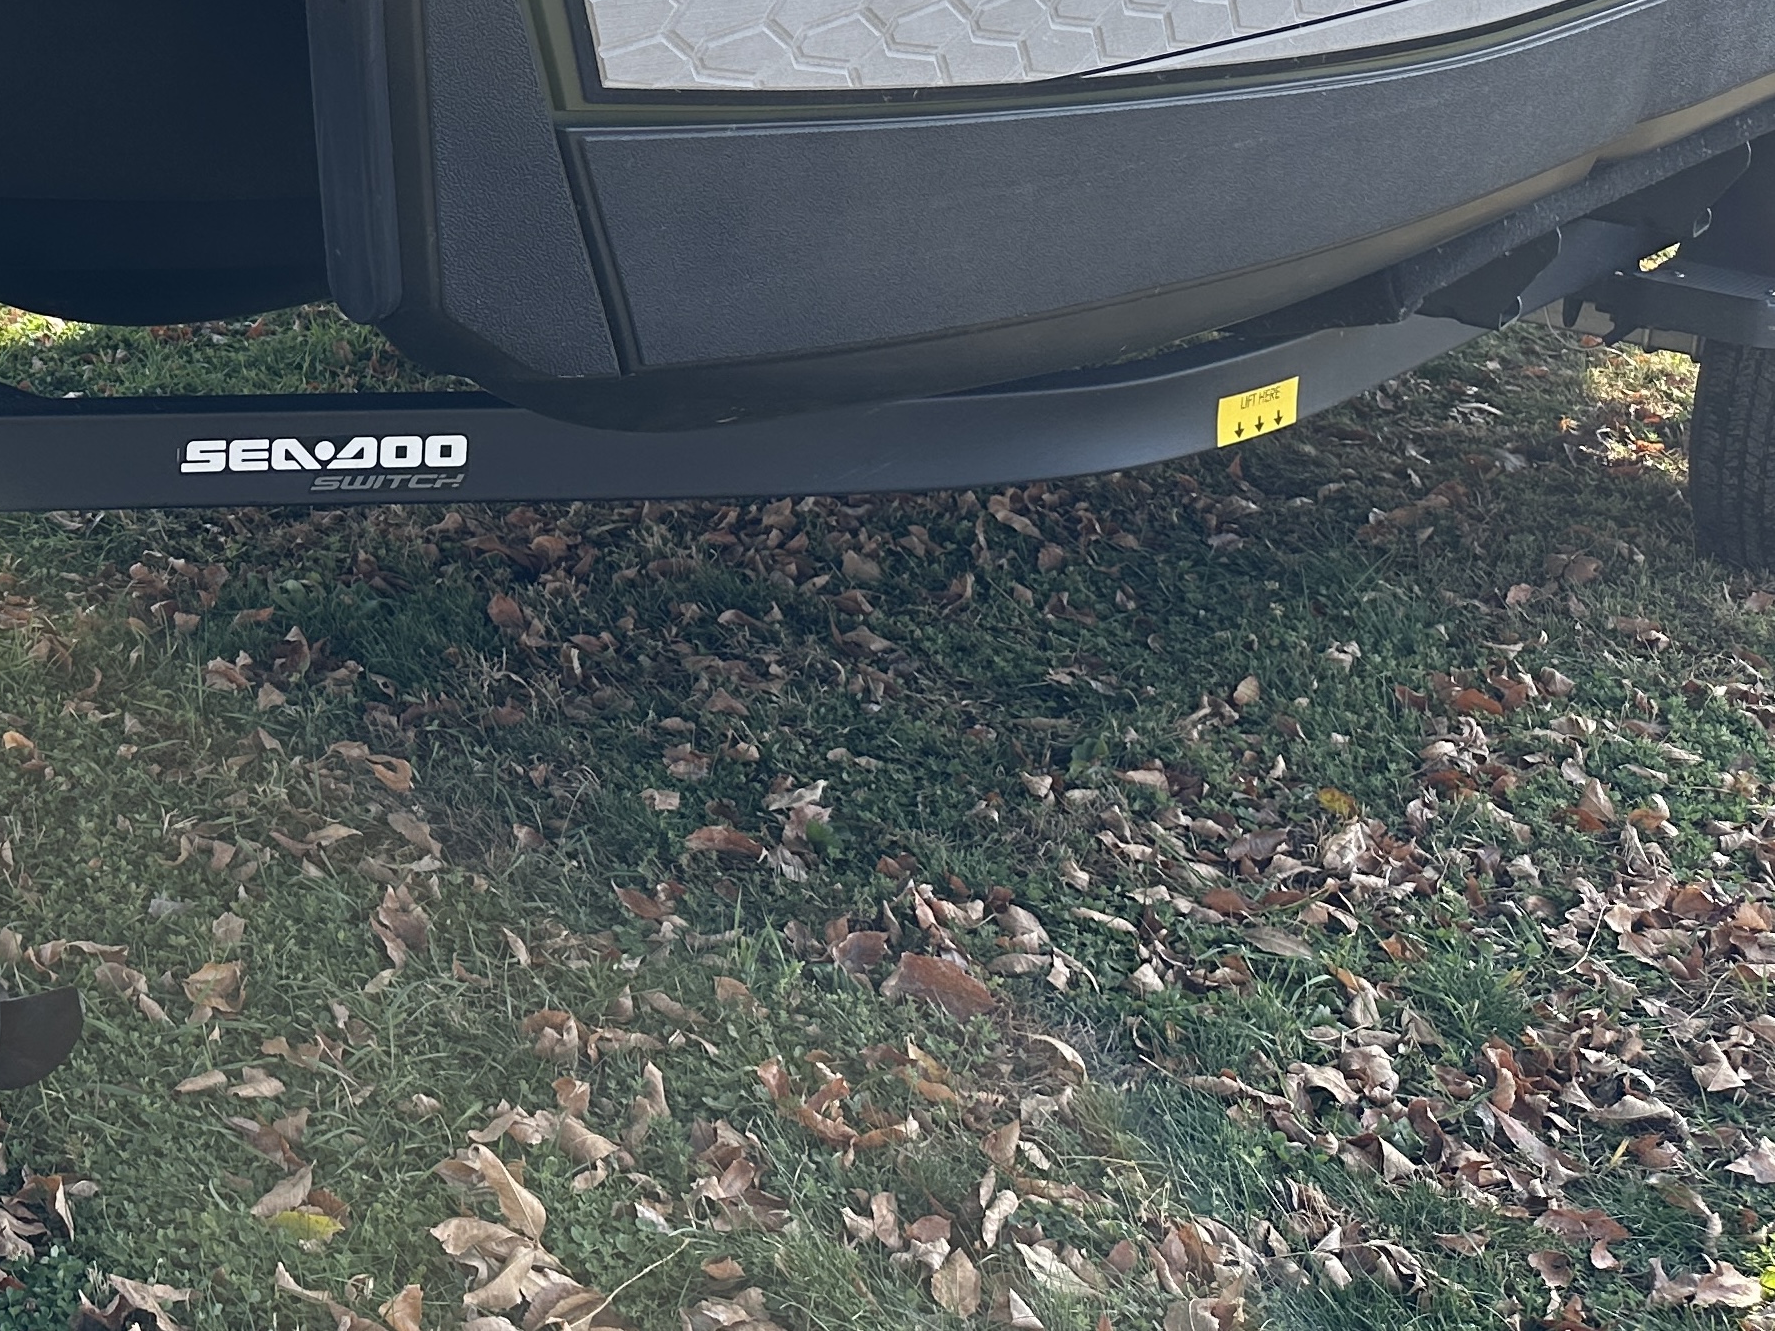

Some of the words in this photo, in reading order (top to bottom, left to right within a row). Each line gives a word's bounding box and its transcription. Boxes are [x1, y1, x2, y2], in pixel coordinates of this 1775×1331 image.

[1240, 392, 1257, 410] LIFT
[1258, 385, 1281, 405] HERE
[310, 473, 465, 491] SWITCH
